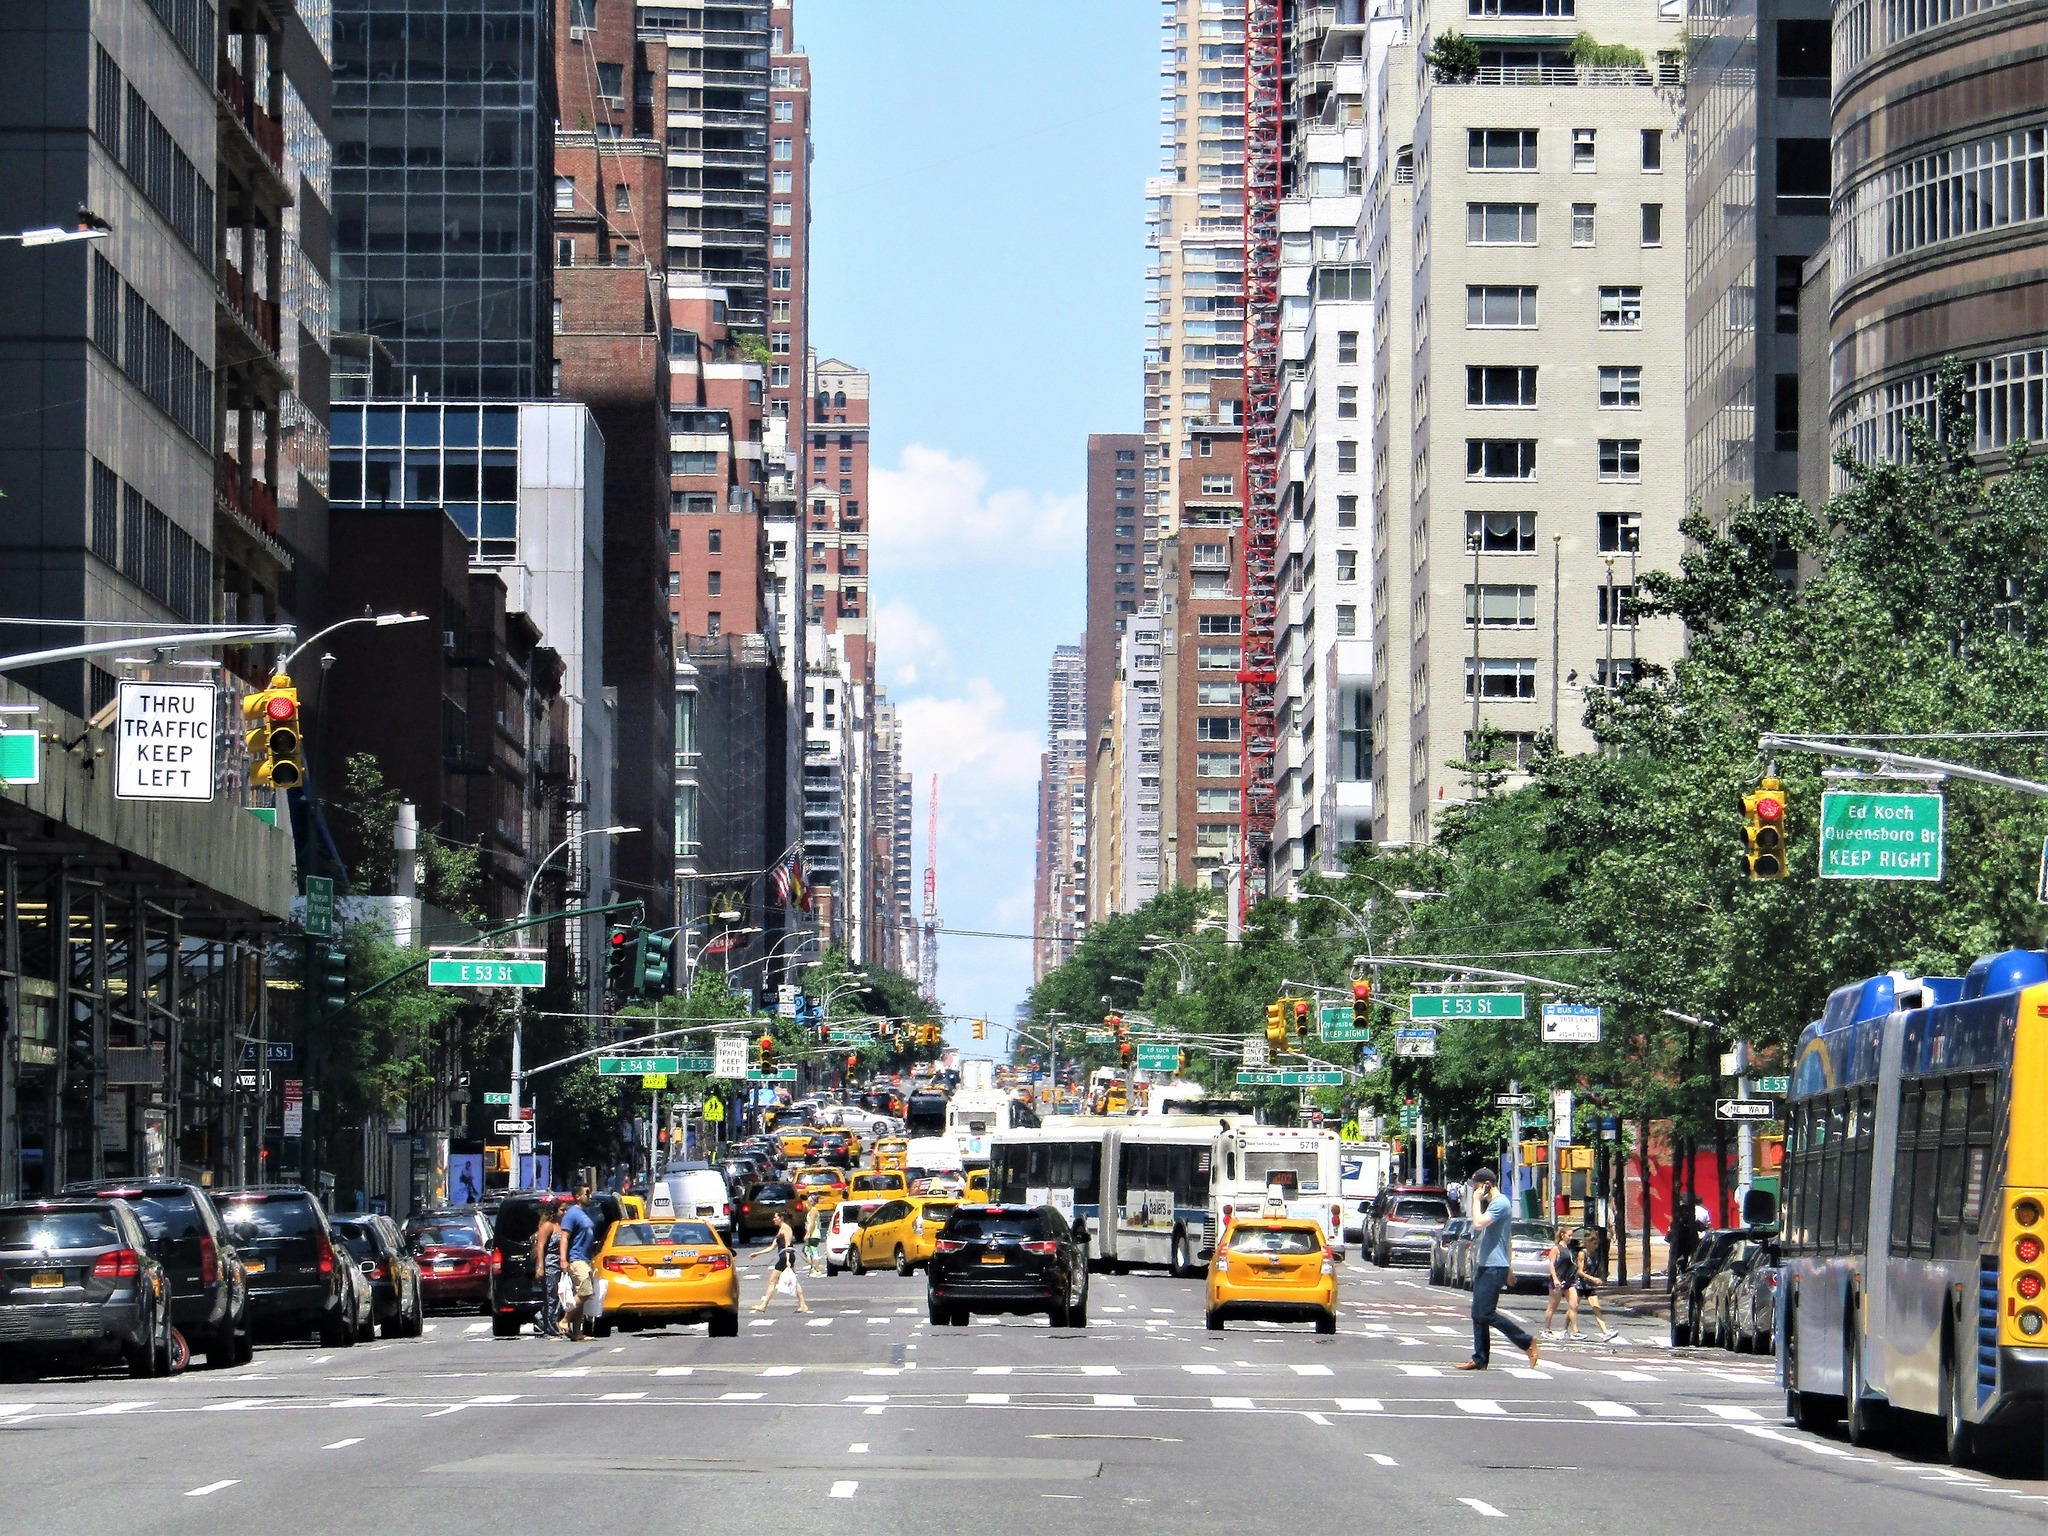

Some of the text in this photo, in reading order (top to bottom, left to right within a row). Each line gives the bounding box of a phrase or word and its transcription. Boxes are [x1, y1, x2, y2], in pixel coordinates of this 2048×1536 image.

[140, 695, 194, 713] THRU
[124, 719, 208, 739] TRAFFIC
[138, 744, 193, 762] KEEP
[138, 768, 191, 787] LEFT
[1849, 805, 1914, 820] Ed Koch
[1825, 826, 1936, 843] Queensboro Br
[1830, 850, 1931, 868] KEEP RIGHT
[461, 965, 512, 980] E 53 St
[1442, 998, 1492, 1014] E 53 St
[1345, 1030, 1365, 1038] RIGHT
[276, 1047, 288, 1057] St
[621, 1061, 656, 1071] E 54 St
[1763, 1079, 1788, 1090] E 53
[1725, 1106, 1766, 1114] ONE WAY
[1299, 1141, 1320, 1150] 5718
